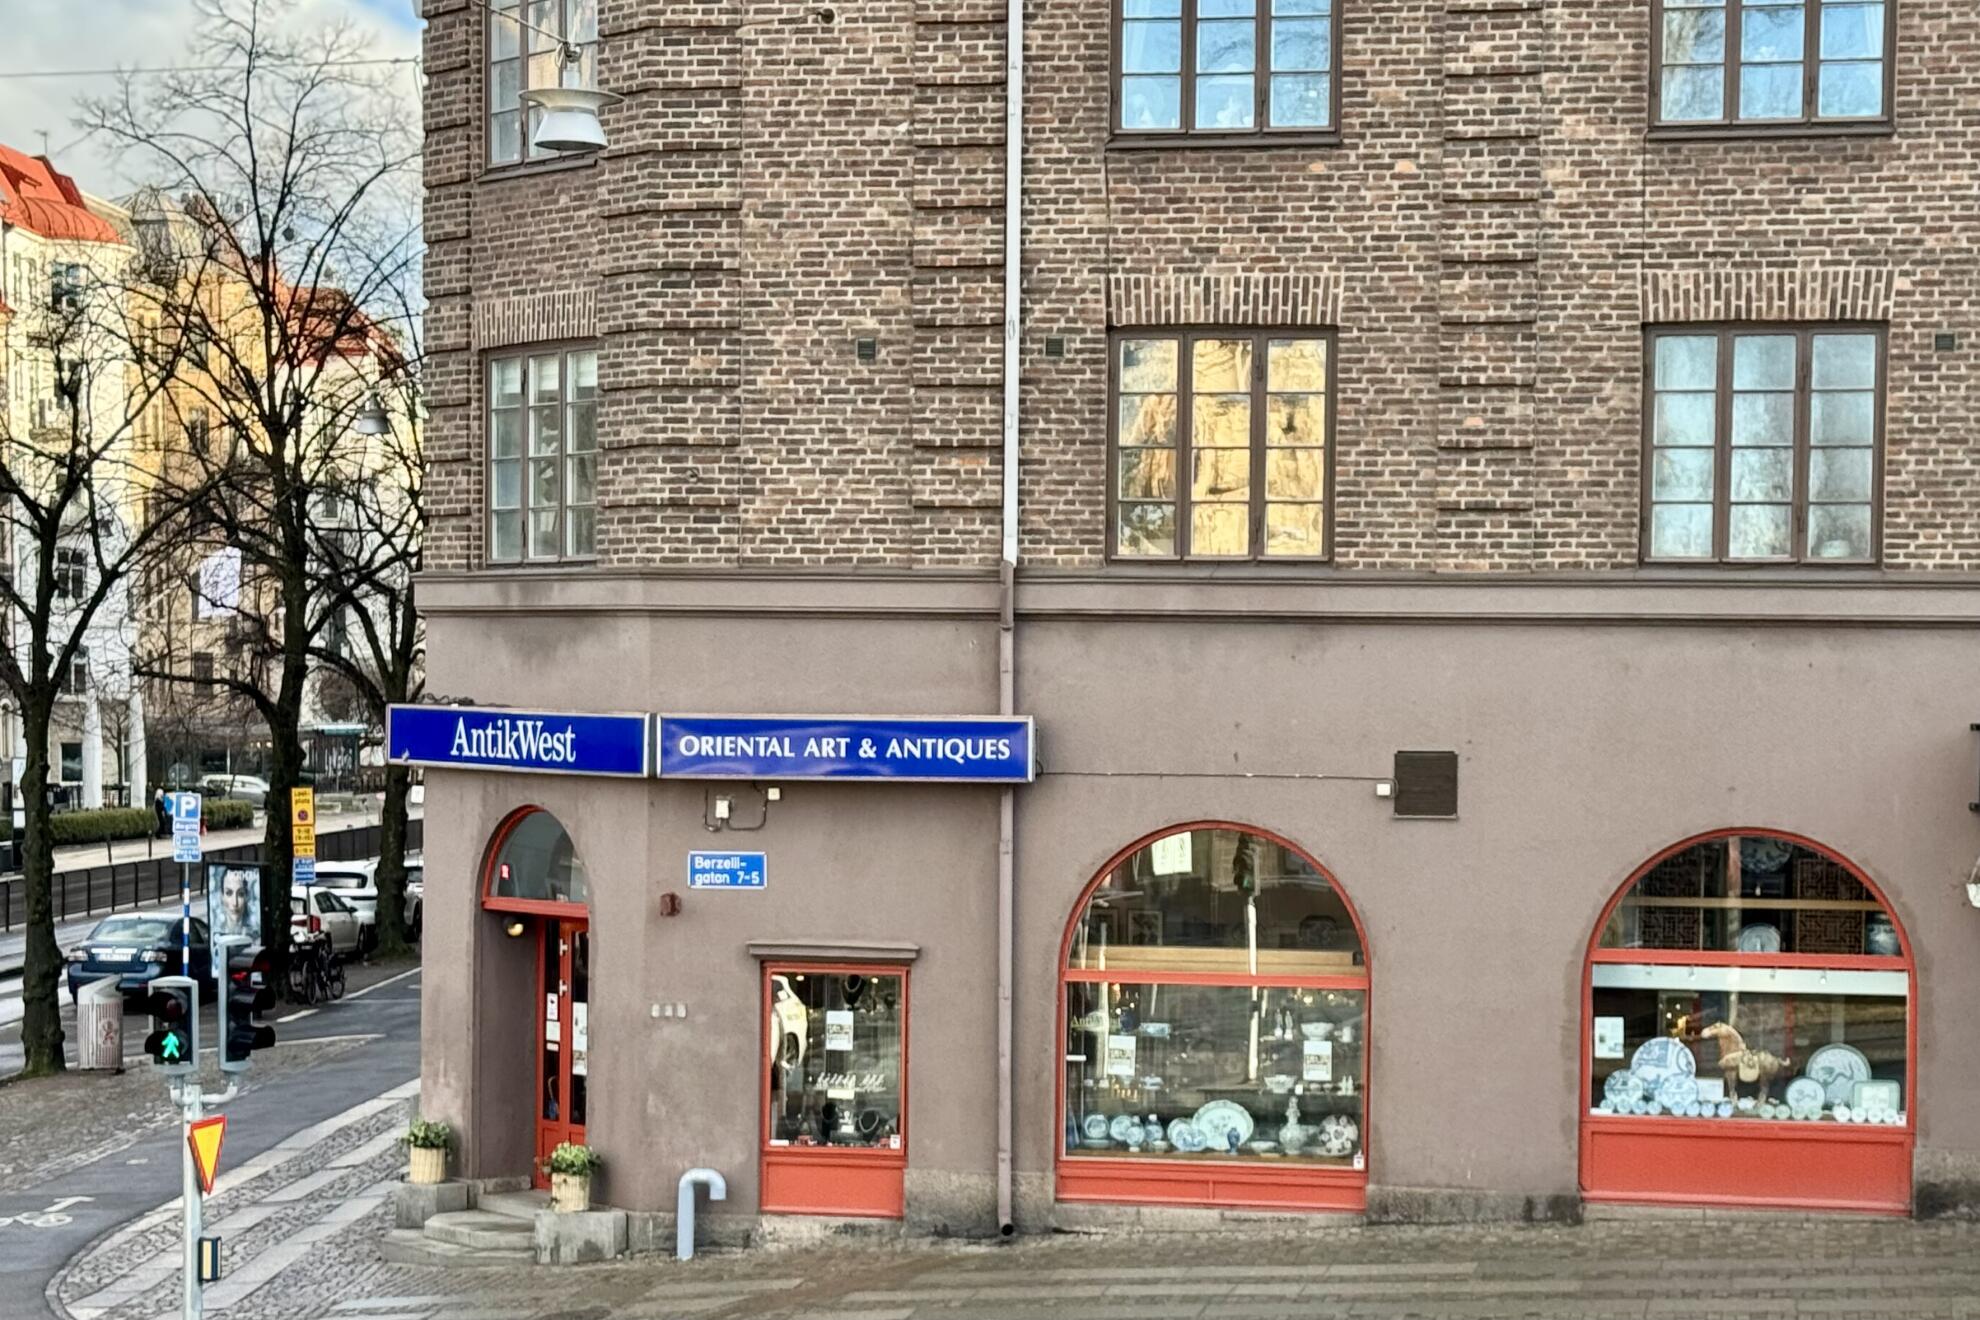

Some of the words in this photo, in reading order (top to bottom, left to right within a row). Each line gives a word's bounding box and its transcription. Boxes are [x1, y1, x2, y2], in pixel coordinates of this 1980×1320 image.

[450, 716, 577, 763] AntikWest
[679, 735, 796, 758] ORIENTAL
[804, 737, 851, 759] ART
[858, 738, 877, 759] &
[886, 738, 1011, 765] ANTIQUES
[180, 796, 197, 818] P
[694, 871, 730, 887] gaten
[737, 871, 760, 884] 7-5
